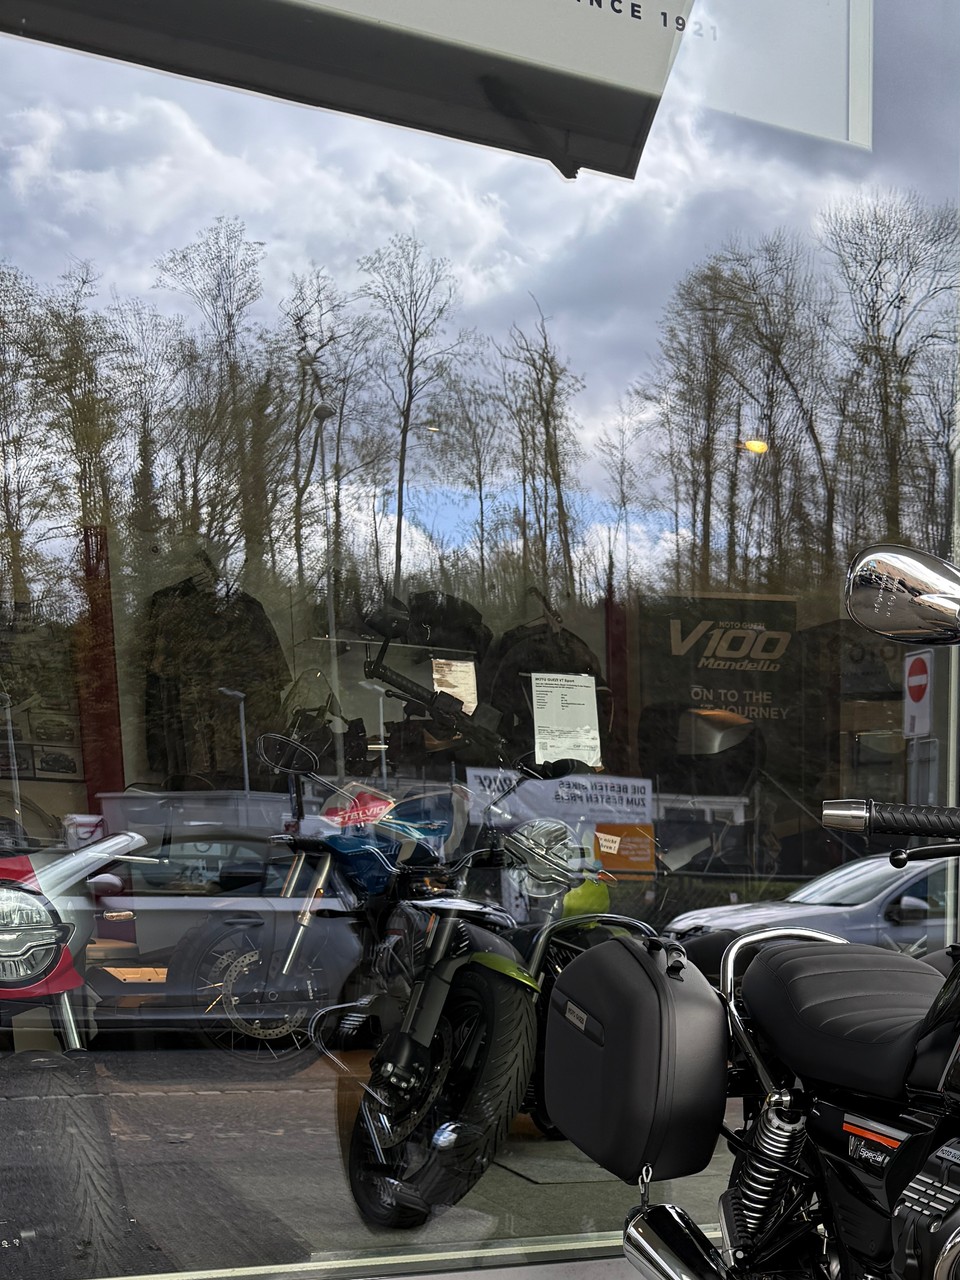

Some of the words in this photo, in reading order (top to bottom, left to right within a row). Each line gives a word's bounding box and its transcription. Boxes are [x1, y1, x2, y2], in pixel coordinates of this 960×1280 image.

[660, 11, 718, 41] 1921
[670, 619, 792, 660] V100
[697, 657, 781, 672] Mandello
[690, 687, 714, 701] ON
[718, 690, 739, 702] TO
[743, 691, 773, 704] THE
[334, 805, 386, 823] STELVIO
[859, 1147, 885, 1165] Special
